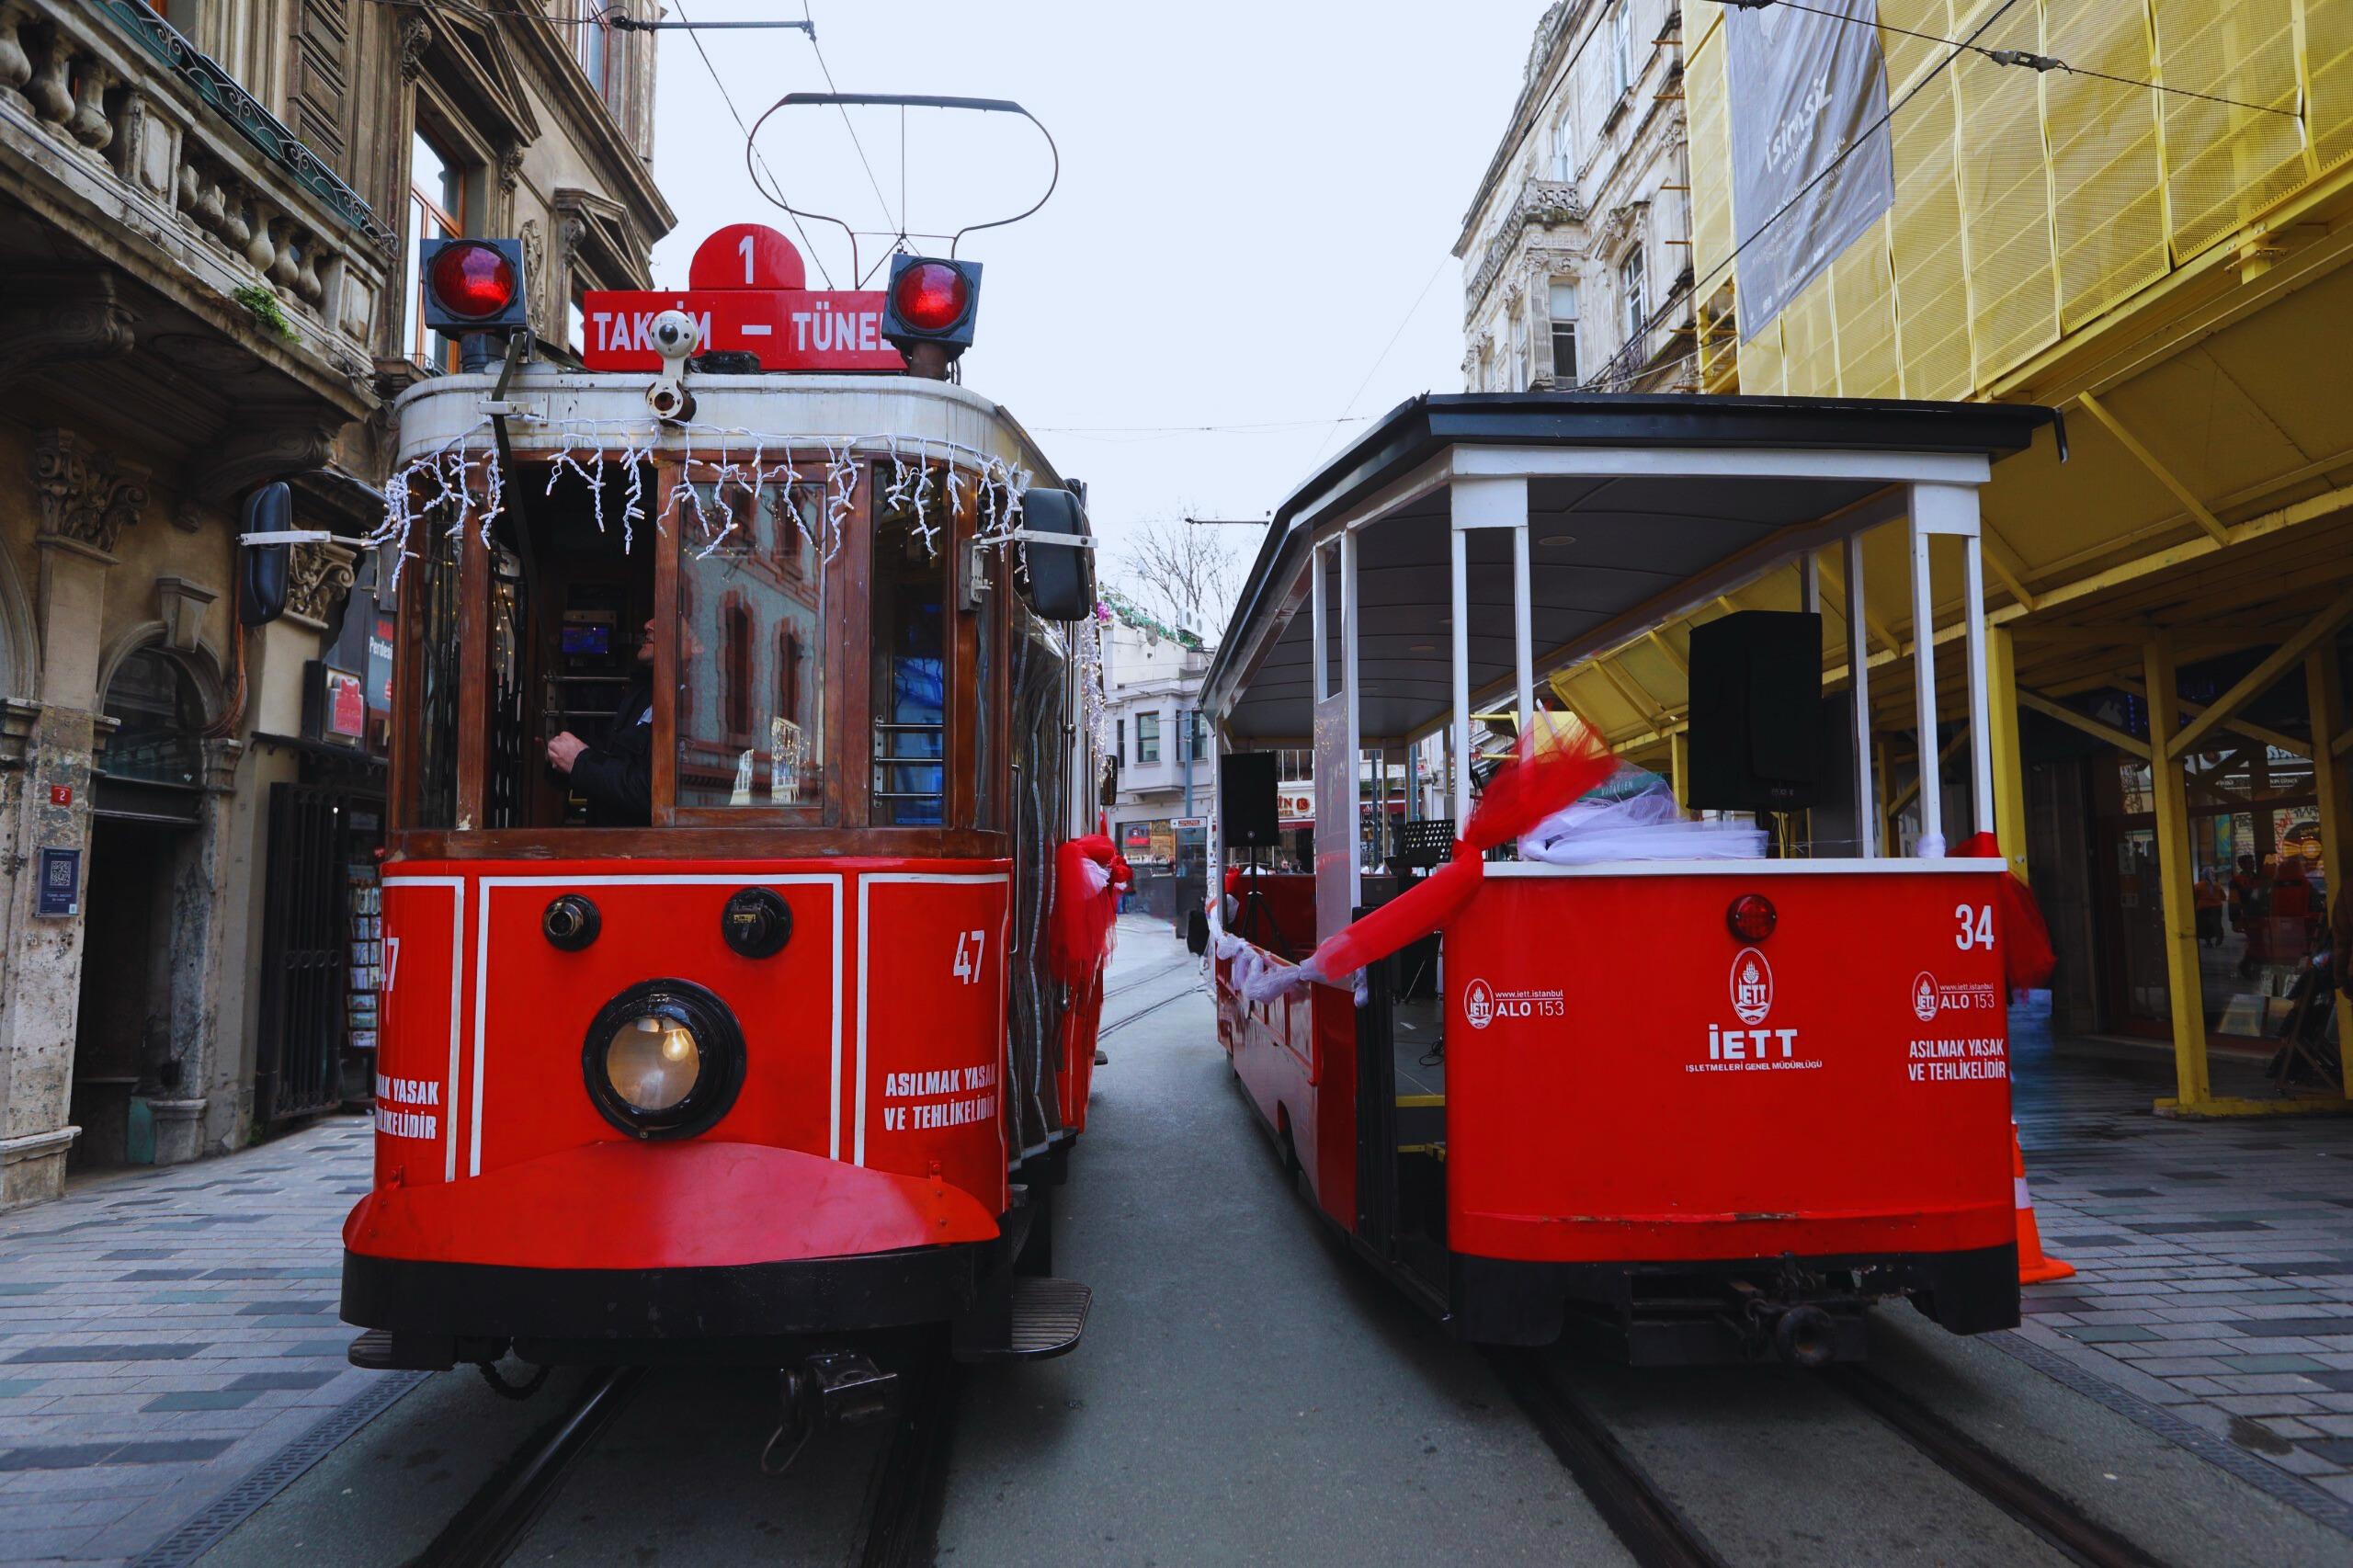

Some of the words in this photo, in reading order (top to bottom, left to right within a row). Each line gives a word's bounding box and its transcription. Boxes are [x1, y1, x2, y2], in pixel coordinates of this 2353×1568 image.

[739, 235, 754, 284] 1
[593, 301, 711, 351] TAKM
[59, 790, 66, 801] 2
[1955, 903, 1995, 950] 34
[952, 929, 985, 985] 47
[1495, 989, 1563, 998] www.iett.istanbul
[1939, 983, 1995, 992] www.iett.istanbul
[1495, 1002, 1532, 1017] ALO
[1537, 1001, 1564, 1016] 153
[1940, 994, 1970, 1009] ALO
[1974, 994, 1995, 1009] 153
[1709, 1023, 1799, 1060] İETT
[1909, 1040, 1966, 1059] ASILMAK
[1968, 1038, 2005, 1057] YASAK
[885, 1069, 960, 1097] ASILMAK
[964, 1062, 996, 1091] YASAK
[1745, 1062, 1771, 1072] GENEL
[1907, 1062, 1926, 1082] VE
[1928, 1058, 2006, 1081] TEHLİKELİDİR
[393, 1078, 439, 1106] YASAK
[884, 1107, 906, 1131] VE
[913, 1092, 995, 1130] TEHLİKELİDİR
